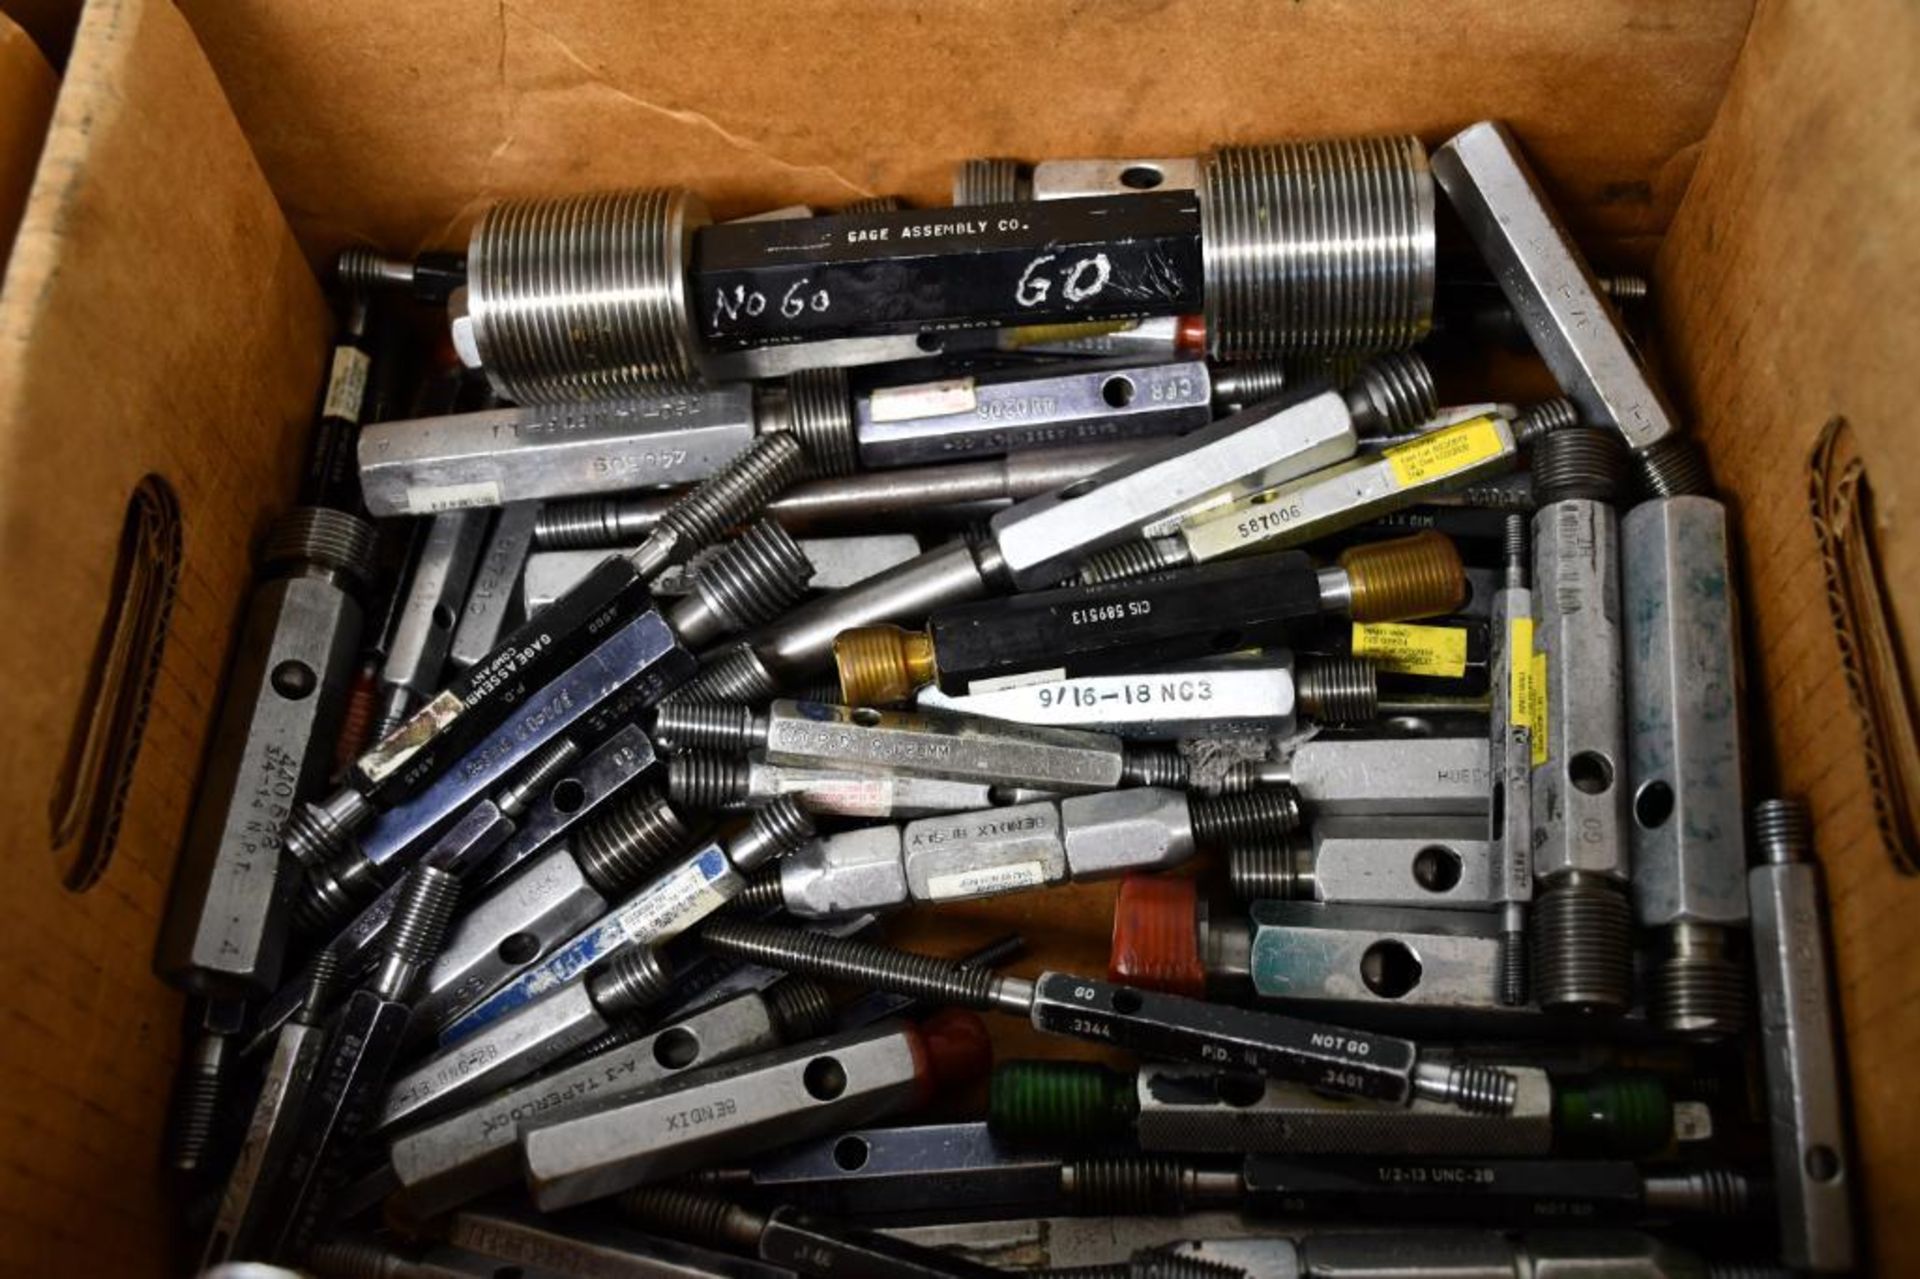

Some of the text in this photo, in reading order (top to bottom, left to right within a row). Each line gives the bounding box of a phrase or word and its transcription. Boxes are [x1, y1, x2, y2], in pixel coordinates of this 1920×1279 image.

[848, 218, 1030, 244] GAGE ASSEMBLY CO.
[1014, 253, 1112, 309] GO
[1237, 503, 1302, 539] 587006
[1072, 599, 1152, 625] CIS 589513
[515, 633, 552, 665] GAGE
[470, 646, 517, 687] COMPANY
[1038, 680, 1215, 708] 9/16-18 NC3
[1580, 815, 1600, 847] GO
[1074, 986, 1095, 1001] GO
[1310, 1031, 1371, 1057] NOT GO
[477, 1066, 611, 1140] TAPERLOCK
[665, 1098, 737, 1132] BENDIX
[1378, 1167, 1496, 1185] 1/2-13 UNC-2B
